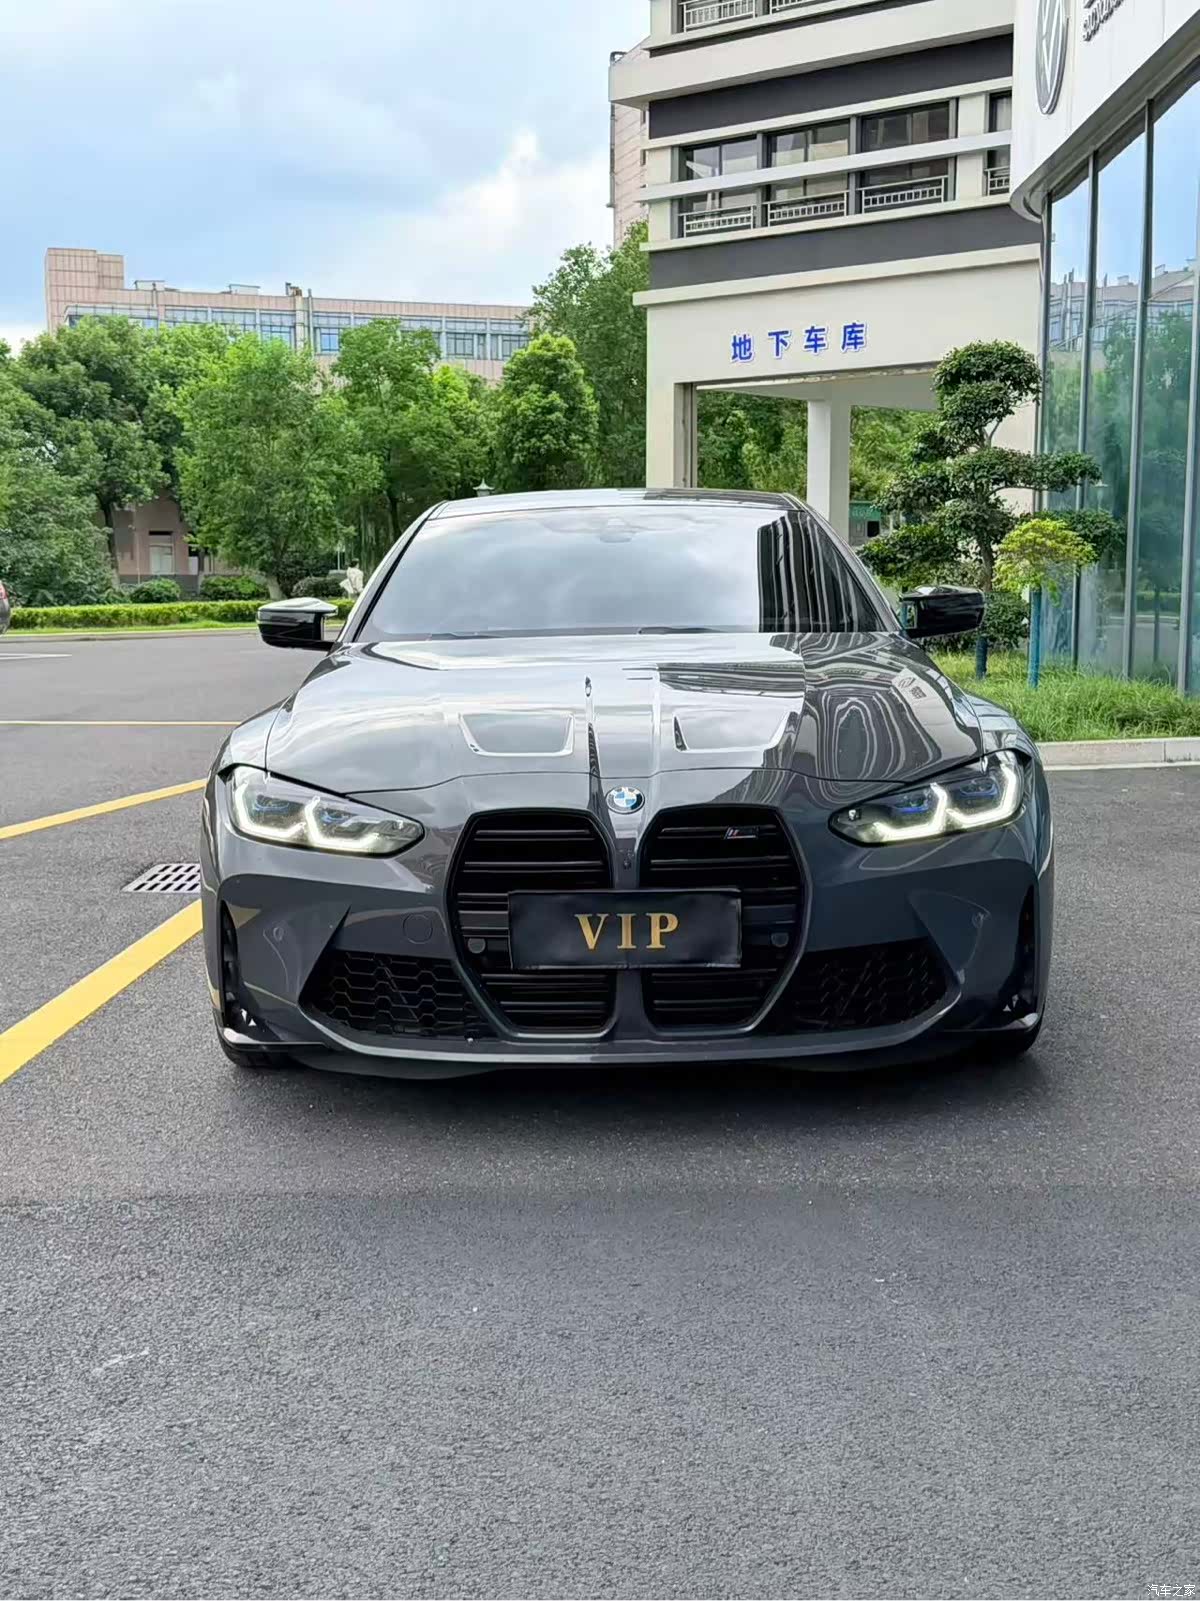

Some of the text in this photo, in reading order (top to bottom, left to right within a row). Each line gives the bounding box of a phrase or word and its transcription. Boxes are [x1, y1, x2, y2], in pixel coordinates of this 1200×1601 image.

[731, 322, 865, 361] 地下车库
[574, 912, 679, 950] VIP
